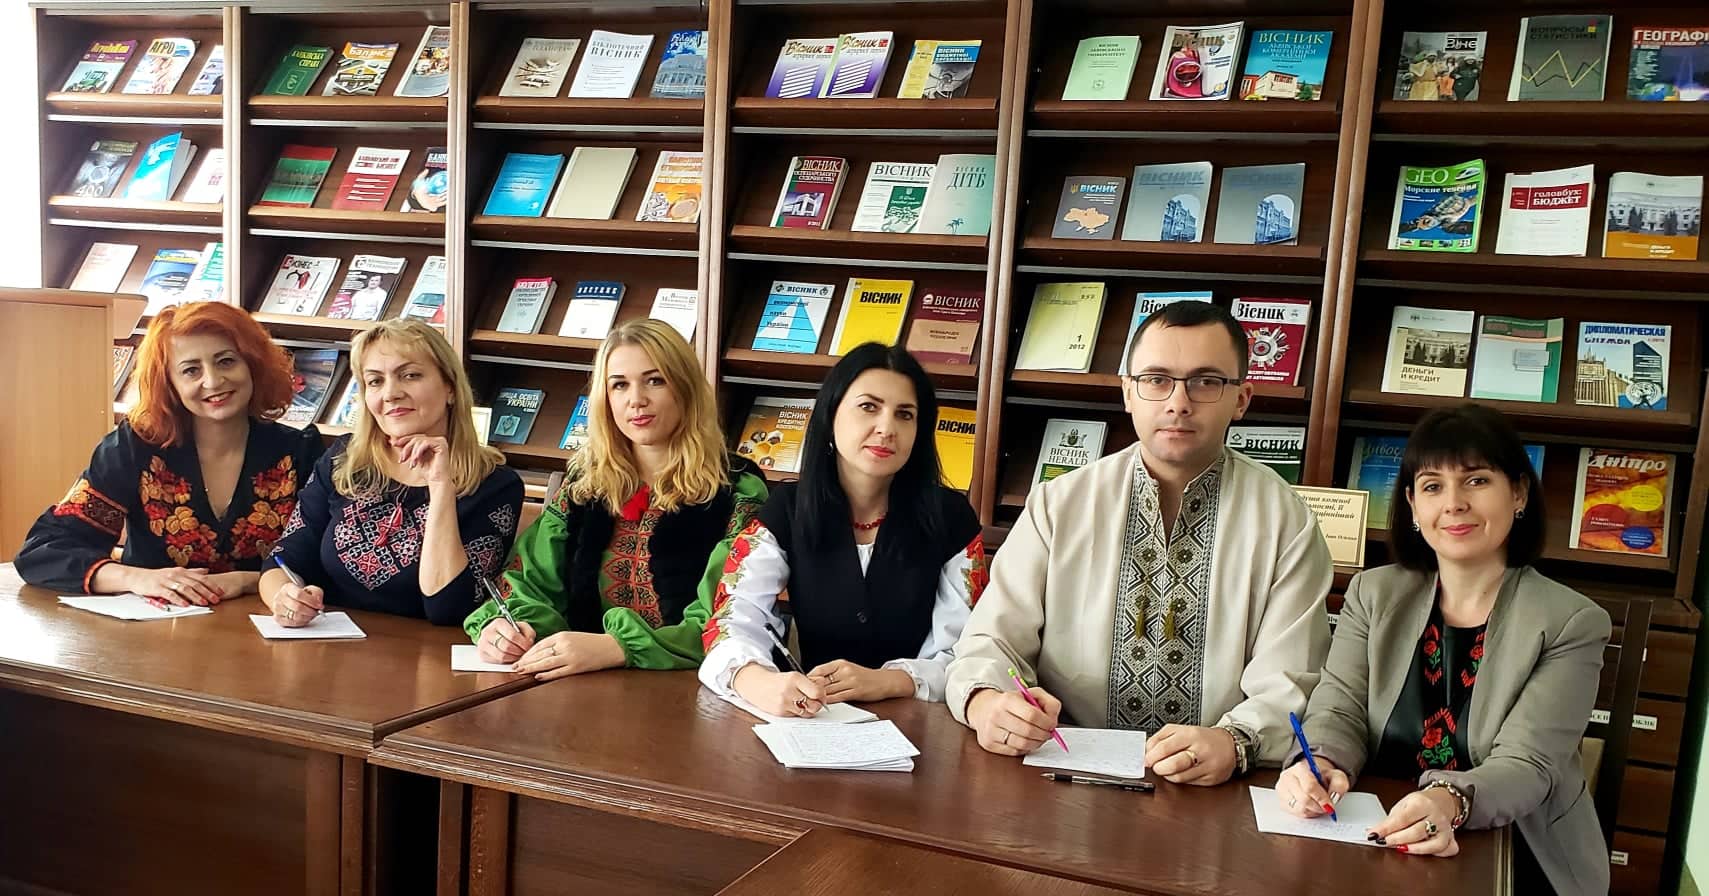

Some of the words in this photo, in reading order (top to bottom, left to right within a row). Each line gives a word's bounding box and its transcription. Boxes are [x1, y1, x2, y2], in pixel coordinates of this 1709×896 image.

[1259, 32, 1325, 44] ВІСНИК
[802, 160, 842, 170] ВІСНИК
[874, 163, 934, 181] ВІСНИК
[1406, 167, 1449, 184] GEO
[1079, 183, 1119, 194] ВІСНИК
[1532, 196, 1582, 208] БЮДЖЕТ
[787, 286, 818, 294] ВІСНИК
[860, 291, 903, 305] ВІСНИК
[934, 295, 982, 309] ВІСНИК
[1140, 299, 1168, 315] Віс
[1235, 302, 1286, 320] Вісник
[1401, 366, 1434, 375] ДЕНЬГИ
[1408, 374, 1440, 382] КРЕДИТ
[936, 419, 977, 436] ВІСНИ
[1246, 439, 1300, 451] ВІСНИК
[1049, 447, 1089, 458] ВІСНИК
[1047, 455, 1088, 466] HERALD
[1588, 454, 1667, 473] Дніпро
